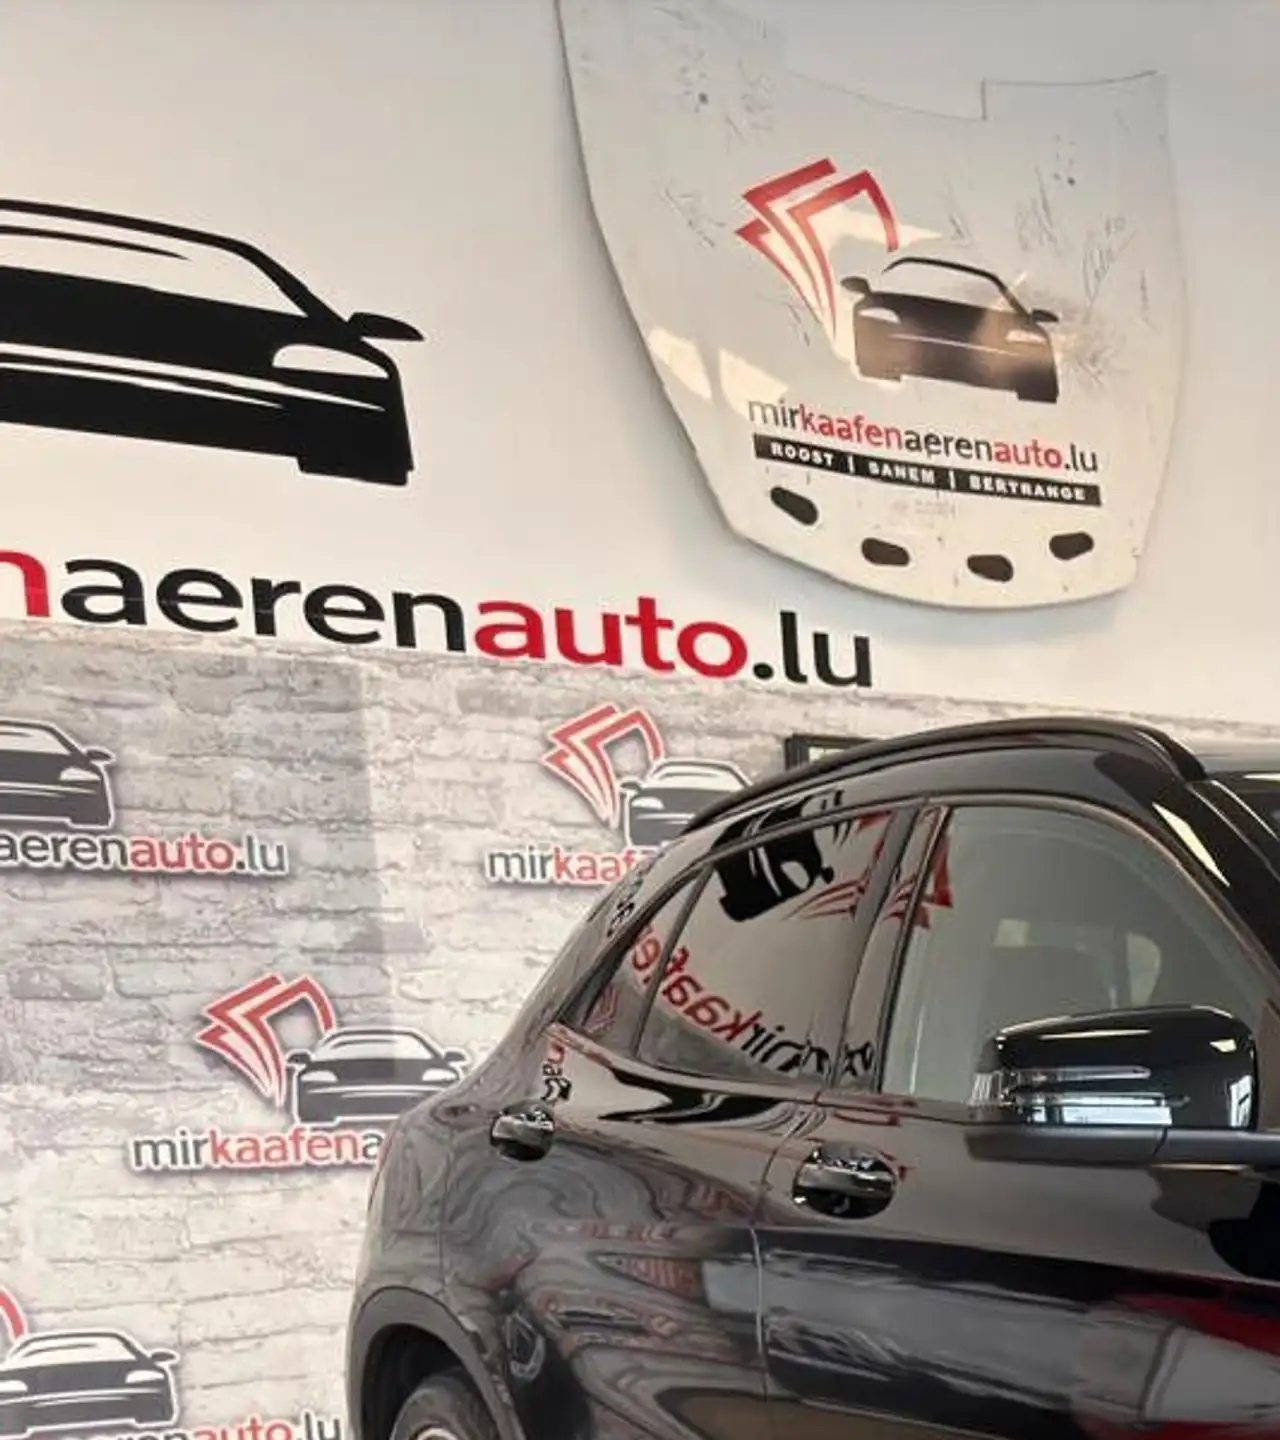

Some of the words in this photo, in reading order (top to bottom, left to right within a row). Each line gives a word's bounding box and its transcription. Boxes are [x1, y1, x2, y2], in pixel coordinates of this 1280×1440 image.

[748, 399, 1098, 473] mirkaafenaerenauto.lu
[769, 441, 834, 467] ROOST
[969, 474, 1087, 502] BERTRANGE
